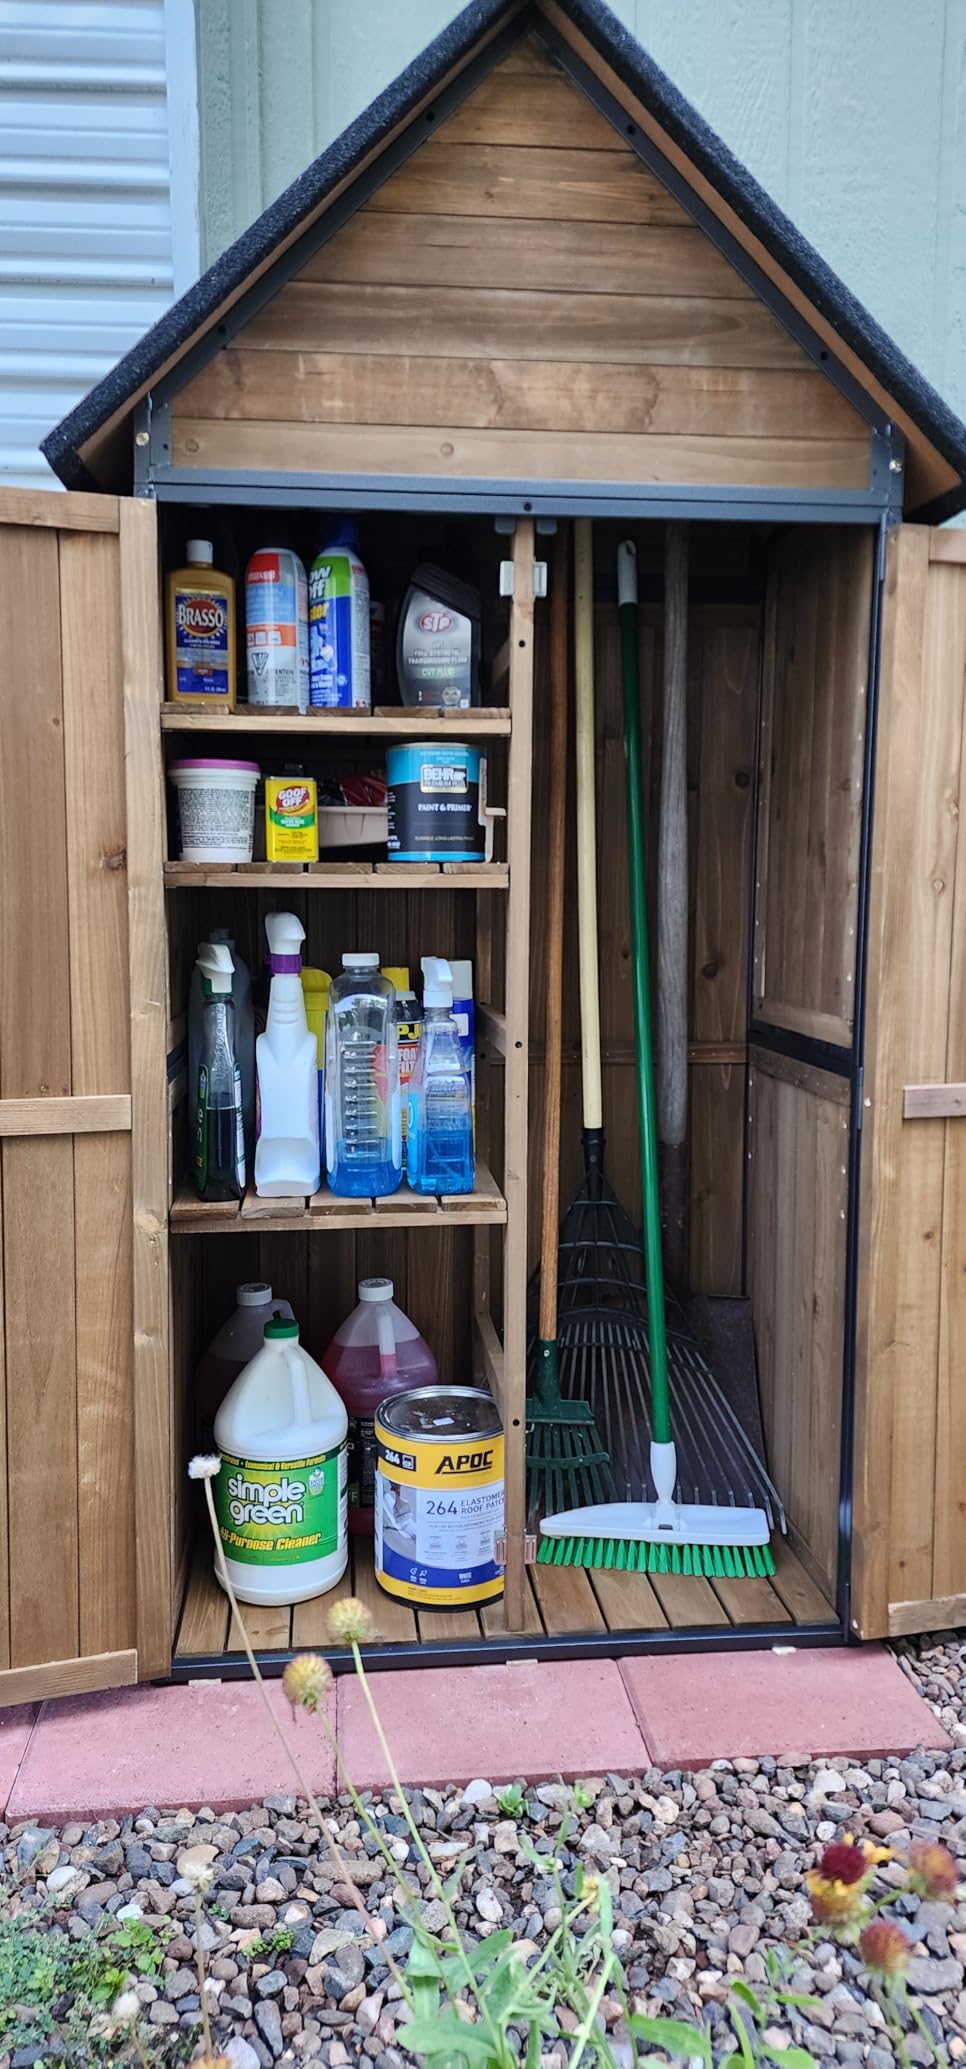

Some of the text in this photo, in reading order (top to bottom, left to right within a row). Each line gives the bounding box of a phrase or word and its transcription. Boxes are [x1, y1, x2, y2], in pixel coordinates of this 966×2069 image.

[177, 604, 225, 628] BRASSO
[423, 612, 450, 632] STP
[423, 767, 454, 781] BEHR
[278, 787, 307, 801] GOOF
[282, 798, 303, 808] OFF
[418, 803, 472, 812] PAINT & PRIMER
[385, 1449, 400, 1465] 264
[434, 1449, 494, 1475] APOC
[228, 1473, 306, 1507] simple
[229, 1501, 303, 1526] green
[426, 1500, 458, 1516] 264
[460, 1503, 484, 1515] ROOF
[275, 1533, 321, 1551] Cleaner
